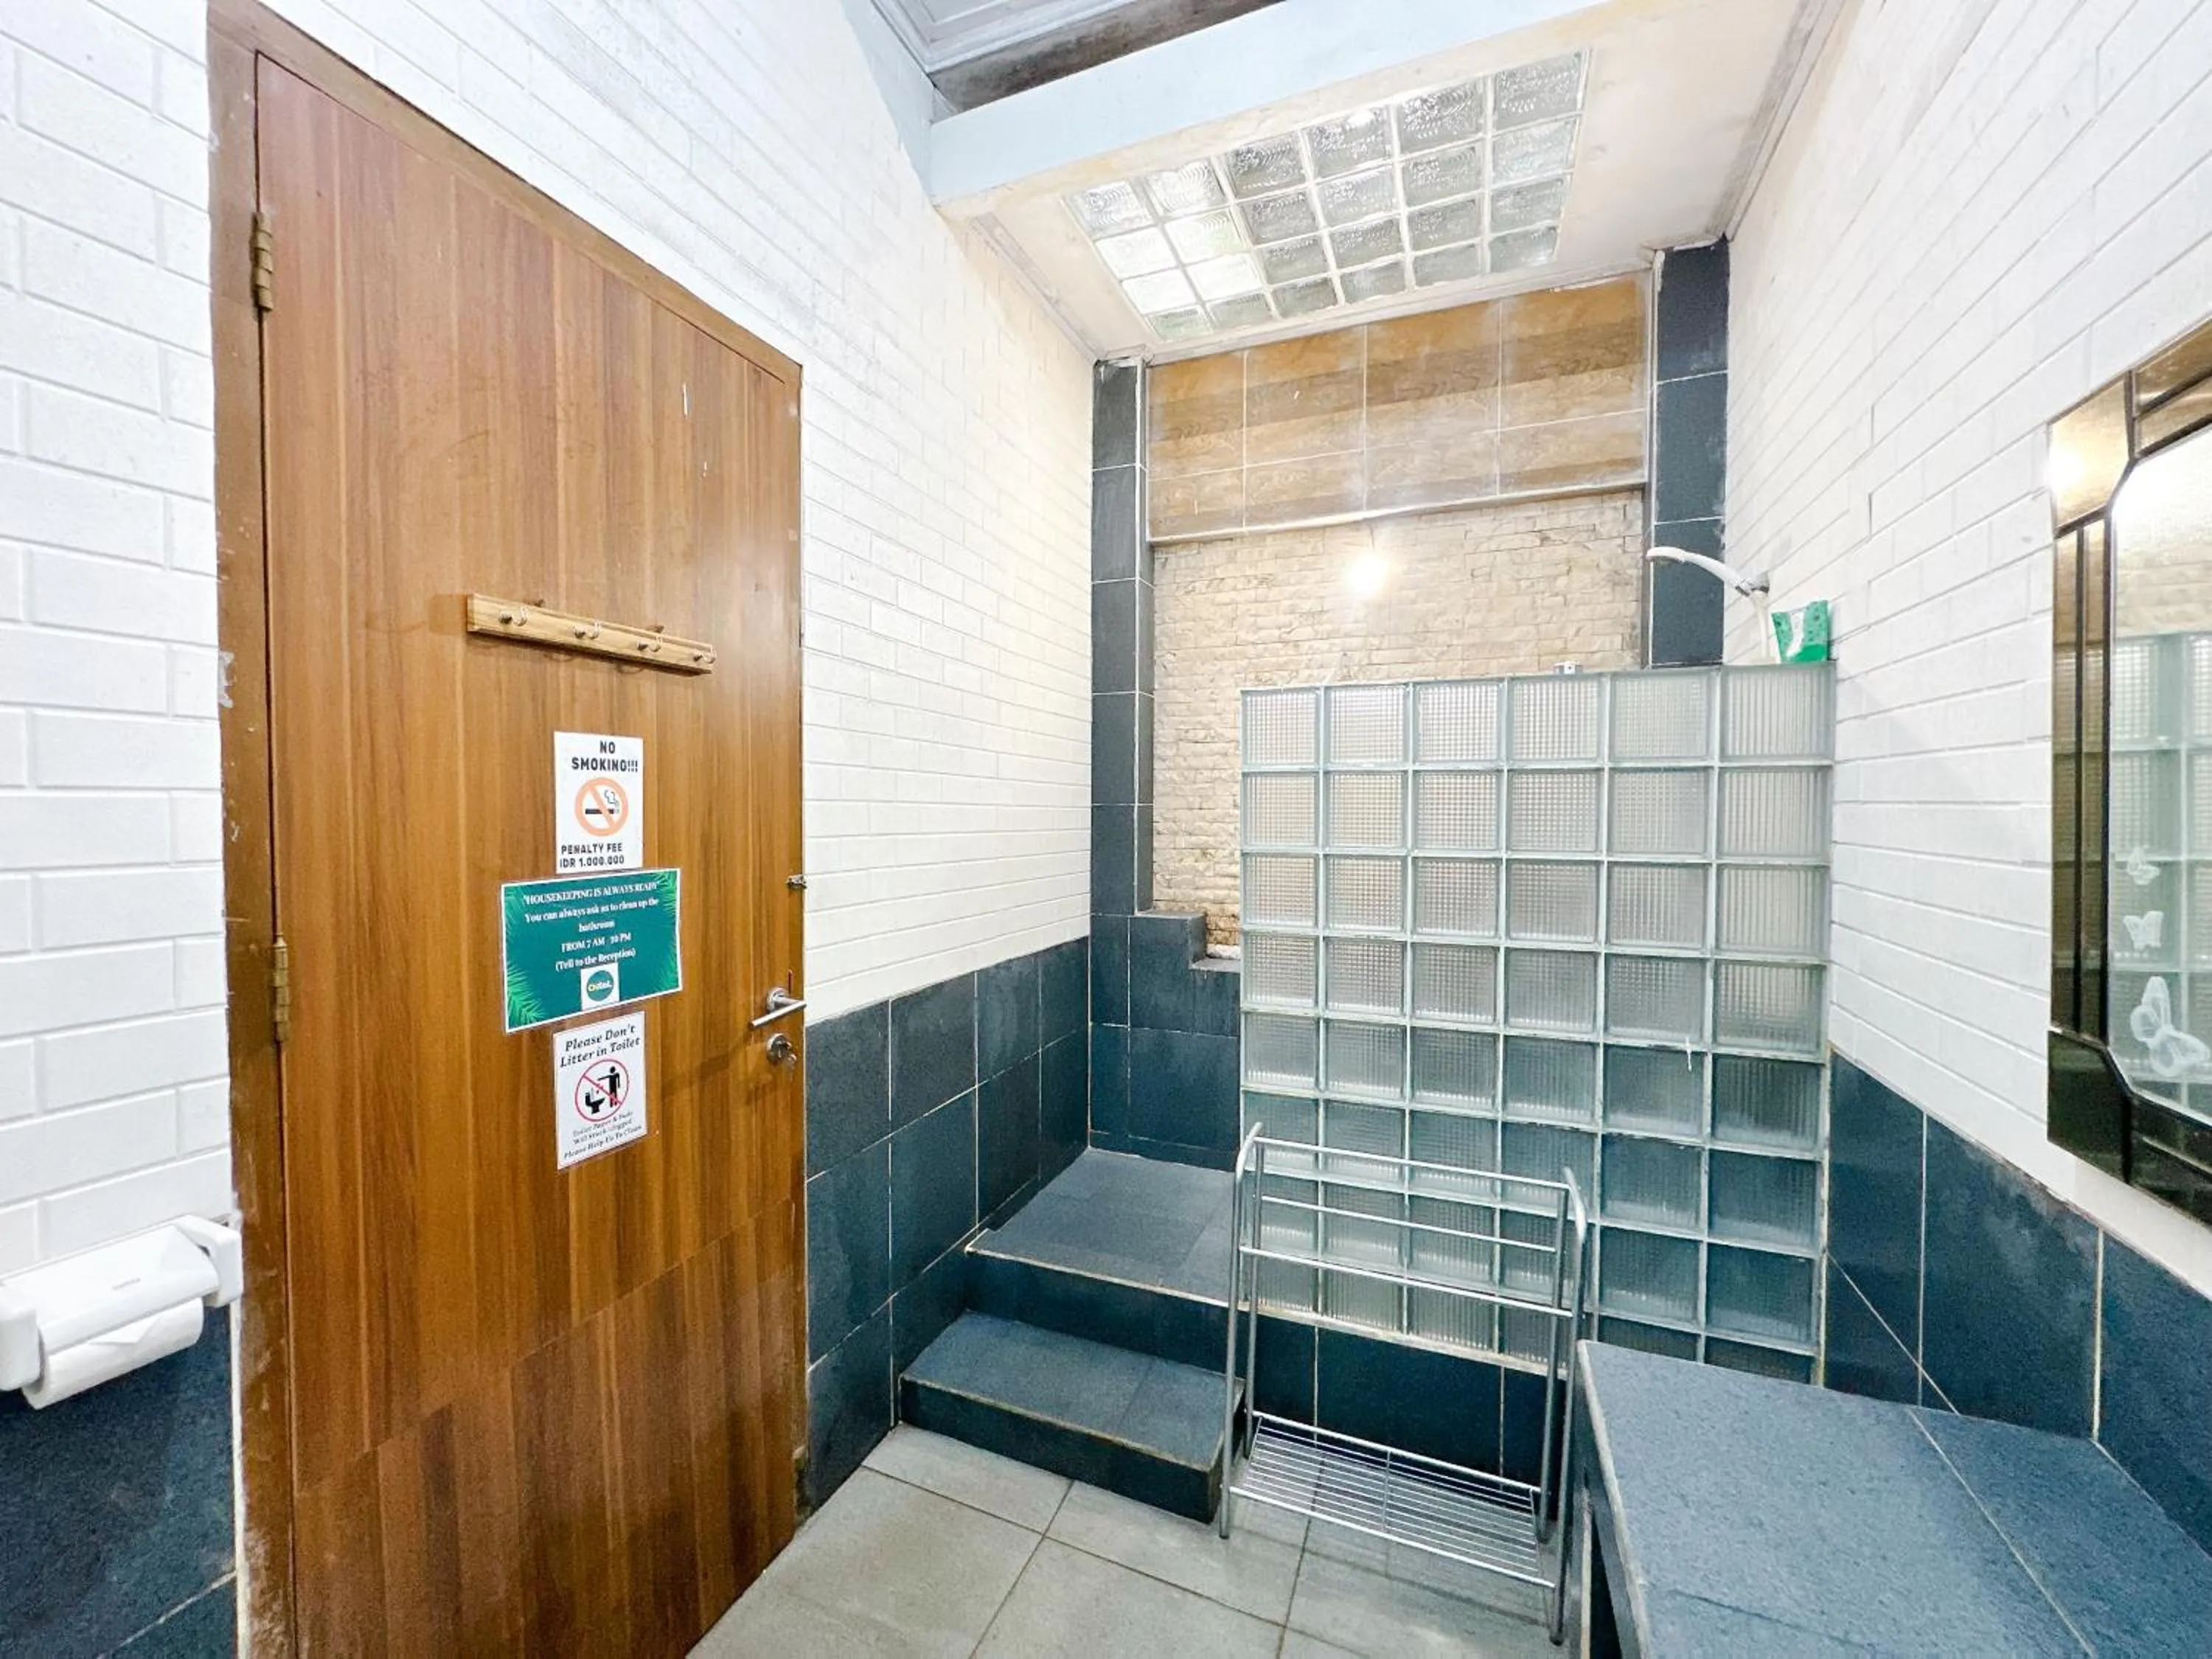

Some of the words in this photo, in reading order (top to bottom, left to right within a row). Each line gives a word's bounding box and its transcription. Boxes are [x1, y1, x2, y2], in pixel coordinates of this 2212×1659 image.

[599, 740, 616, 754] NO
[571, 757, 639, 773] SMOKING!!!
[561, 844, 604, 855] PENALTY
[607, 843, 623, 852] FEE
[560, 858, 576, 868] IDR
[579, 855, 625, 868] 1.000.000
[594, 887, 602, 897] IS
[603, 884, 633, 896] ALWAYS
[525, 914, 542, 923] You
[543, 912, 558, 921] can
[559, 908, 586, 919] always
[587, 904, 599, 914] ask
[601, 905, 610, 913] us
[611, 903, 618, 911] to
[619, 901, 638, 911] clean
[639, 900, 648, 908] up
[649, 897, 659, 906] the
[579, 920, 615, 932] bathroom
[561, 940, 585, 953] FROM
[586, 939, 591, 948] 7
[592, 936, 605, 947] AM
[619, 932, 632, 942] PM
[556, 959, 574, 972] (Tell
[575, 959, 583, 967] to
[585, 956, 597, 965] the
[598, 947, 636, 962] Reception)
[566, 1035, 602, 1051] Please
[605, 1023, 636, 1040] Don't
[560, 1051, 595, 1068] Litter
[597, 1046, 607, 1057] in
[610, 1037, 640, 1052] Toilet
